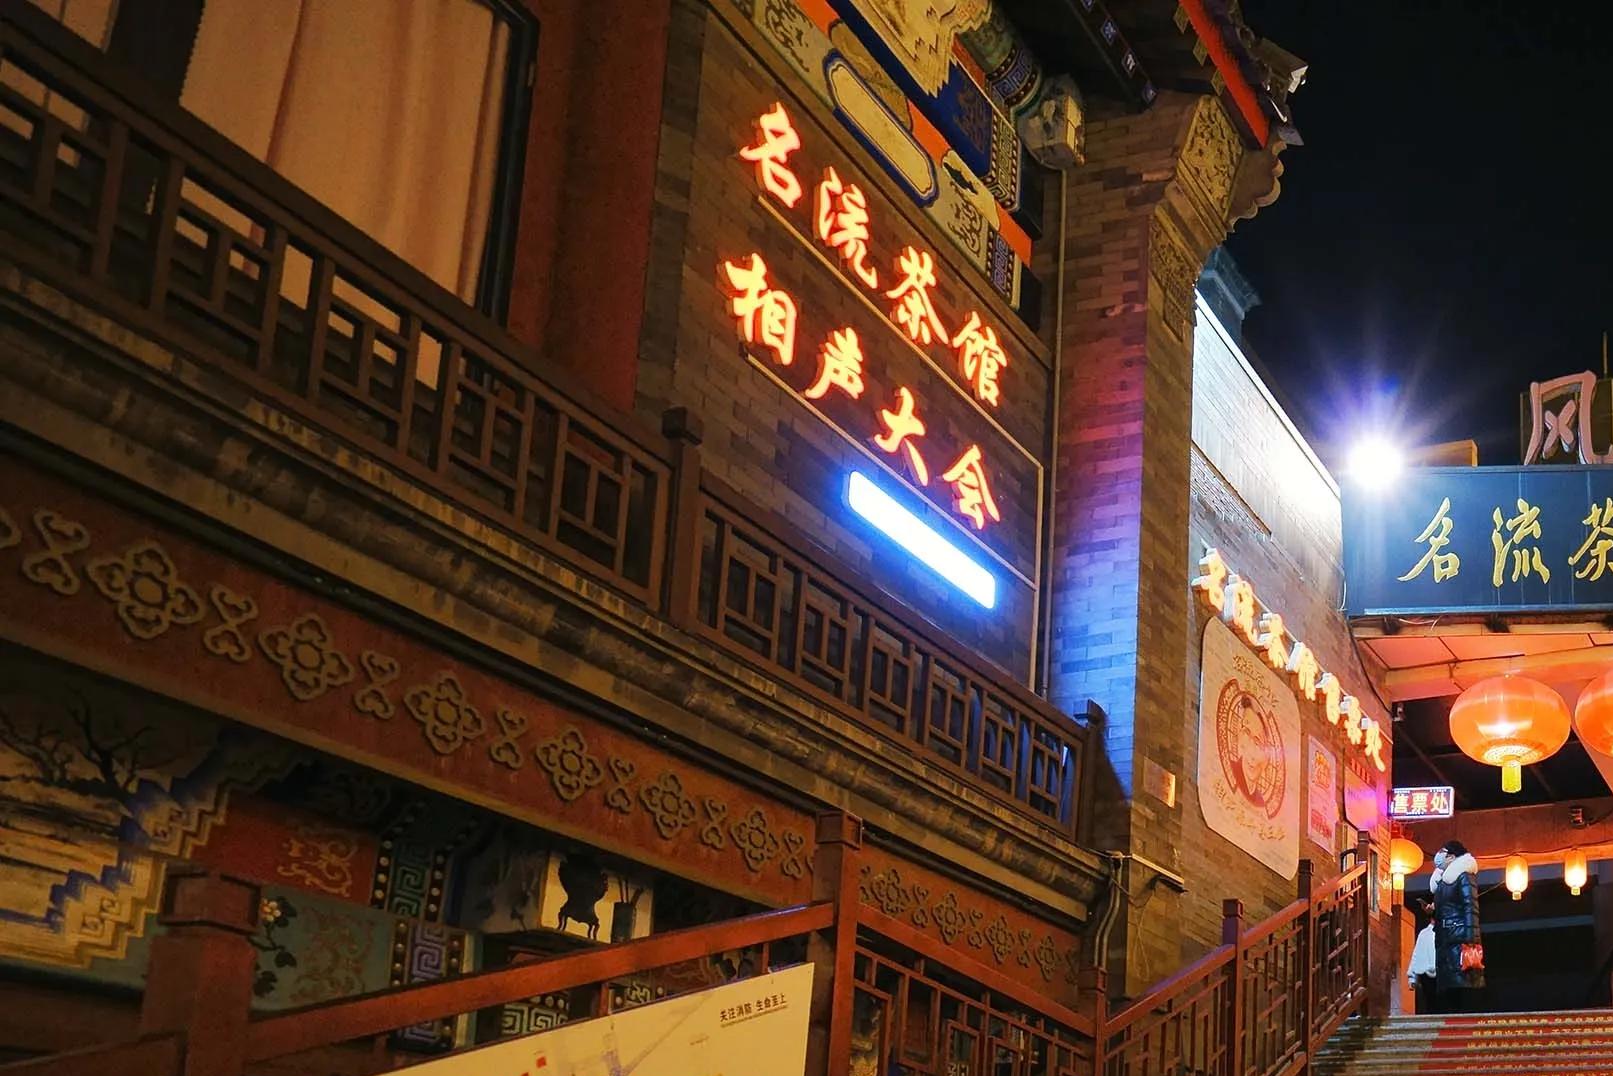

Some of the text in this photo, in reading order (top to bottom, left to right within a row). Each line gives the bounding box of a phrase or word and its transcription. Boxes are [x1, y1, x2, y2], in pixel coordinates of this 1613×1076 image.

[724, 253, 1001, 530] 相声大会
[739, 103, 1008, 407] 名流茶馆
[1393, 792, 1449, 815] 售票处
